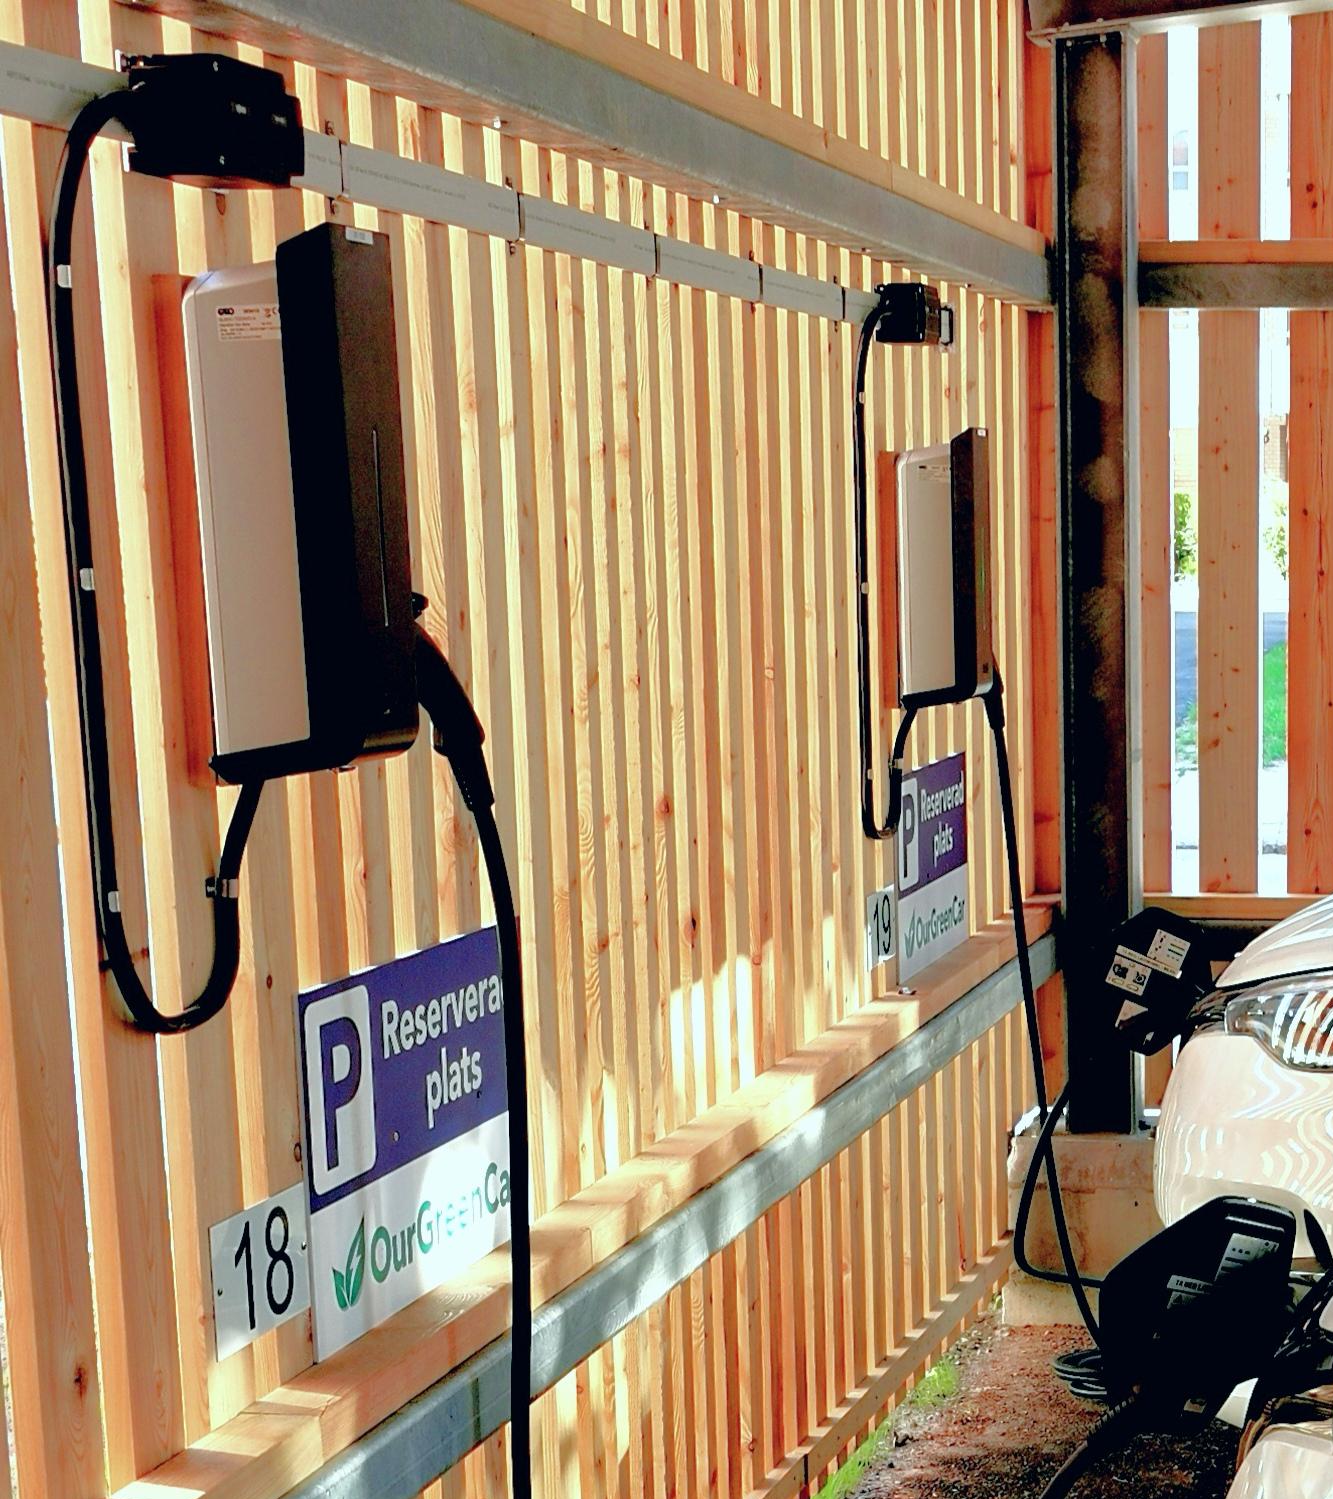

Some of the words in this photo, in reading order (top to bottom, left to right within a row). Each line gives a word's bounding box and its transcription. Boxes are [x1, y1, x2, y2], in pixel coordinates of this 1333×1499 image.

[902, 793, 915, 878] P
[920, 770, 964, 822] Reserverad
[933, 821, 953, 868] plats
[873, 894, 891, 956] 19
[915, 895, 965, 949] OurGreenCar
[381, 974, 504, 1060] Reservera
[319, 1016, 362, 1173] P
[426, 1046, 483, 1129] plats
[370, 1161, 512, 1283] OurGreenCa
[234, 1205, 295, 1331] 18
